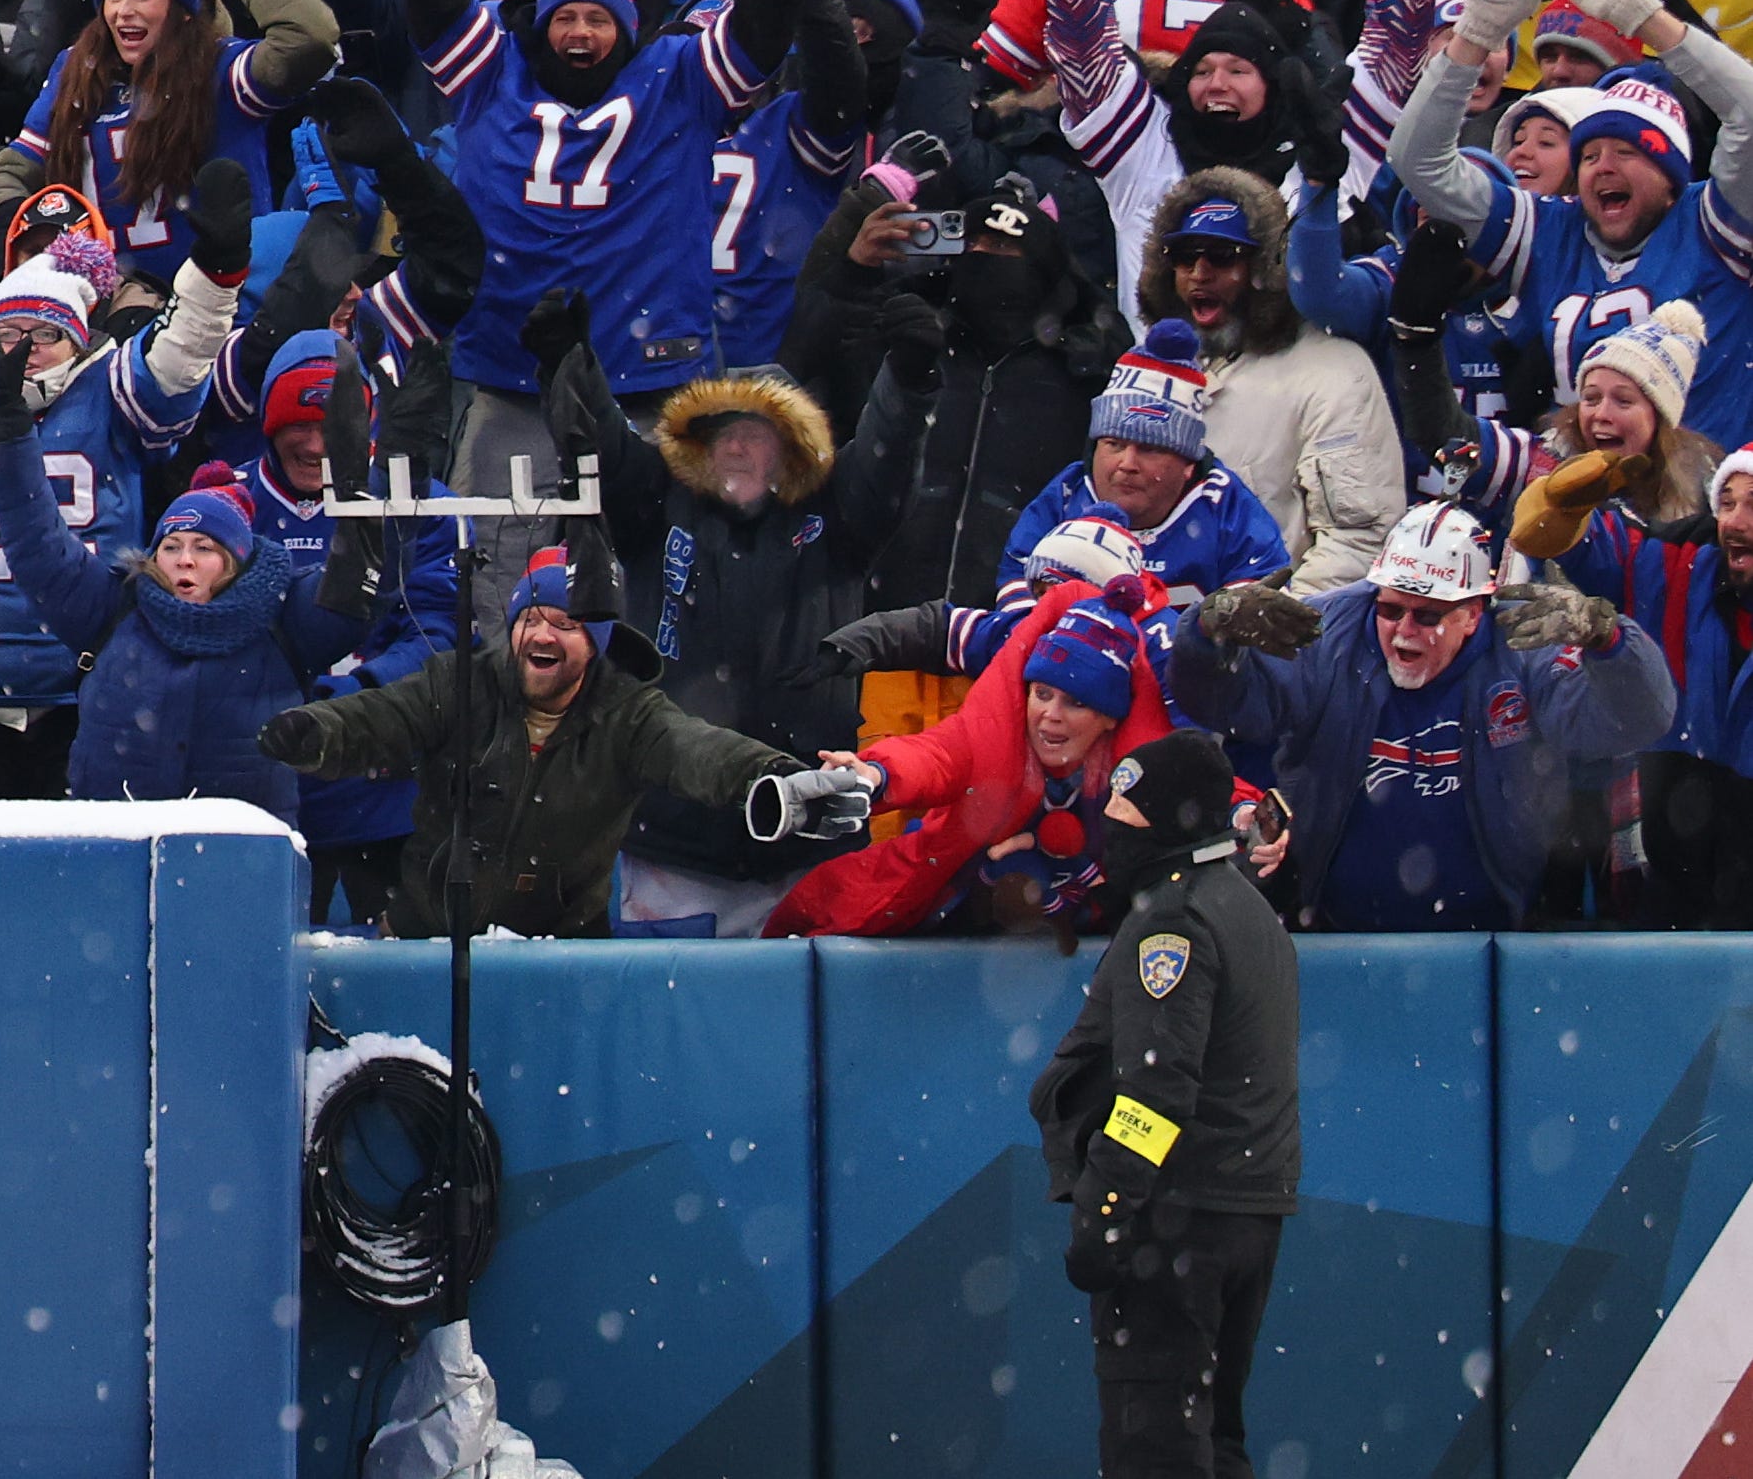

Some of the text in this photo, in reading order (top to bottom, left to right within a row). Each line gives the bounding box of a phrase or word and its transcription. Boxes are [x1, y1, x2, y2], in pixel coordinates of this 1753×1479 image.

[524, 96, 632, 207] 17
[283, 537, 323, 551] BILLS
[1387, 546, 1453, 586] FEAR THIS
